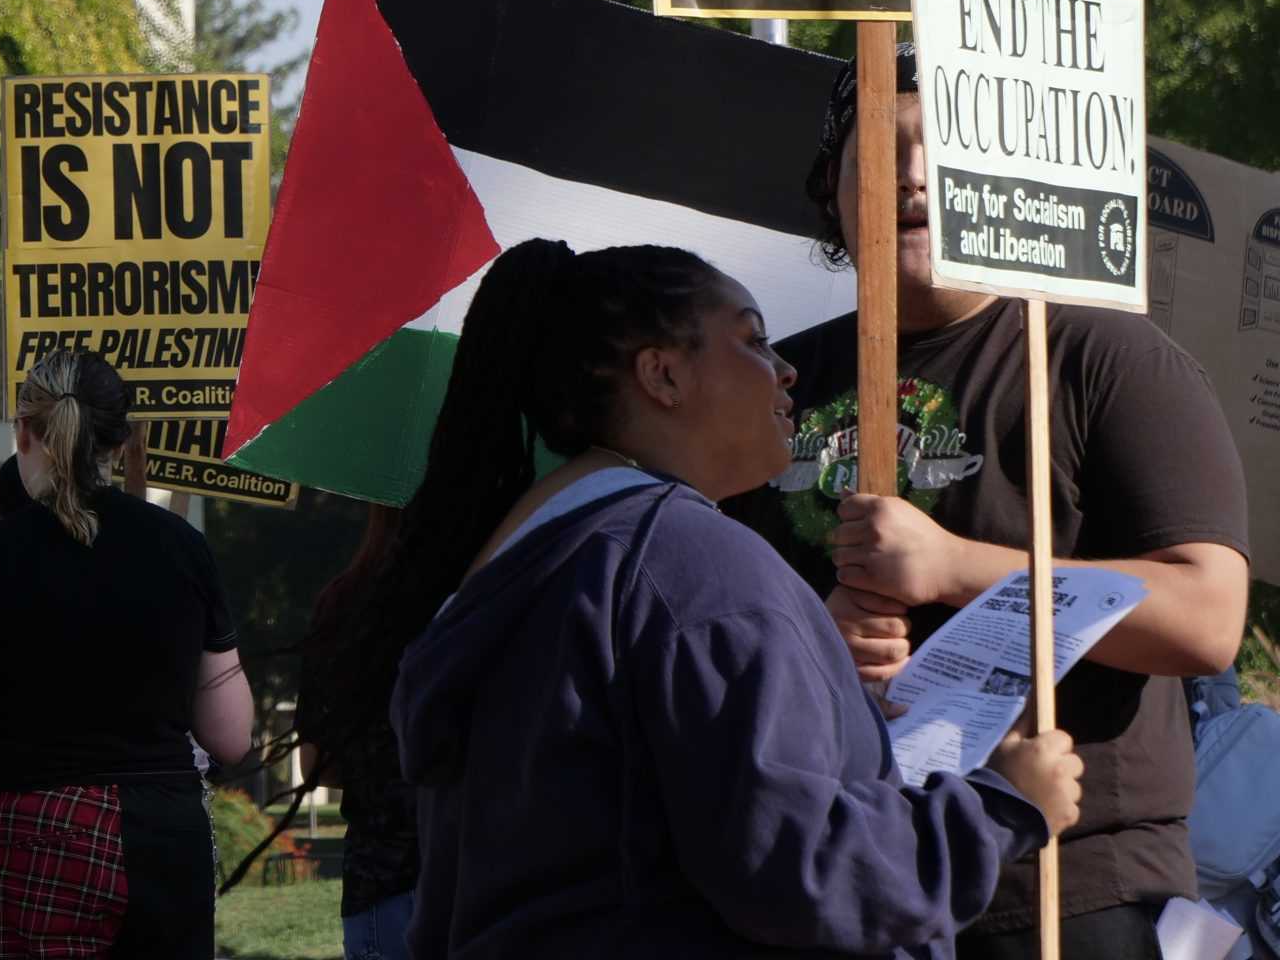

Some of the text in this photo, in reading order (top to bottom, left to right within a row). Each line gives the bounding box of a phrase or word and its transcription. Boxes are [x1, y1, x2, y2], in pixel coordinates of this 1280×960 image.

[14, 79, 261, 139] RESISTANCE
[934, 65, 1135, 175] OCCUPATION!
[20, 141, 253, 243] IS NOT
[944, 177, 1085, 230] Party for Socialism
[960, 225, 988, 258] and
[989, 226, 1065, 269] Liberation
[162, 385, 235, 406] Coaliti
[203, 468, 286, 496] Coalition
